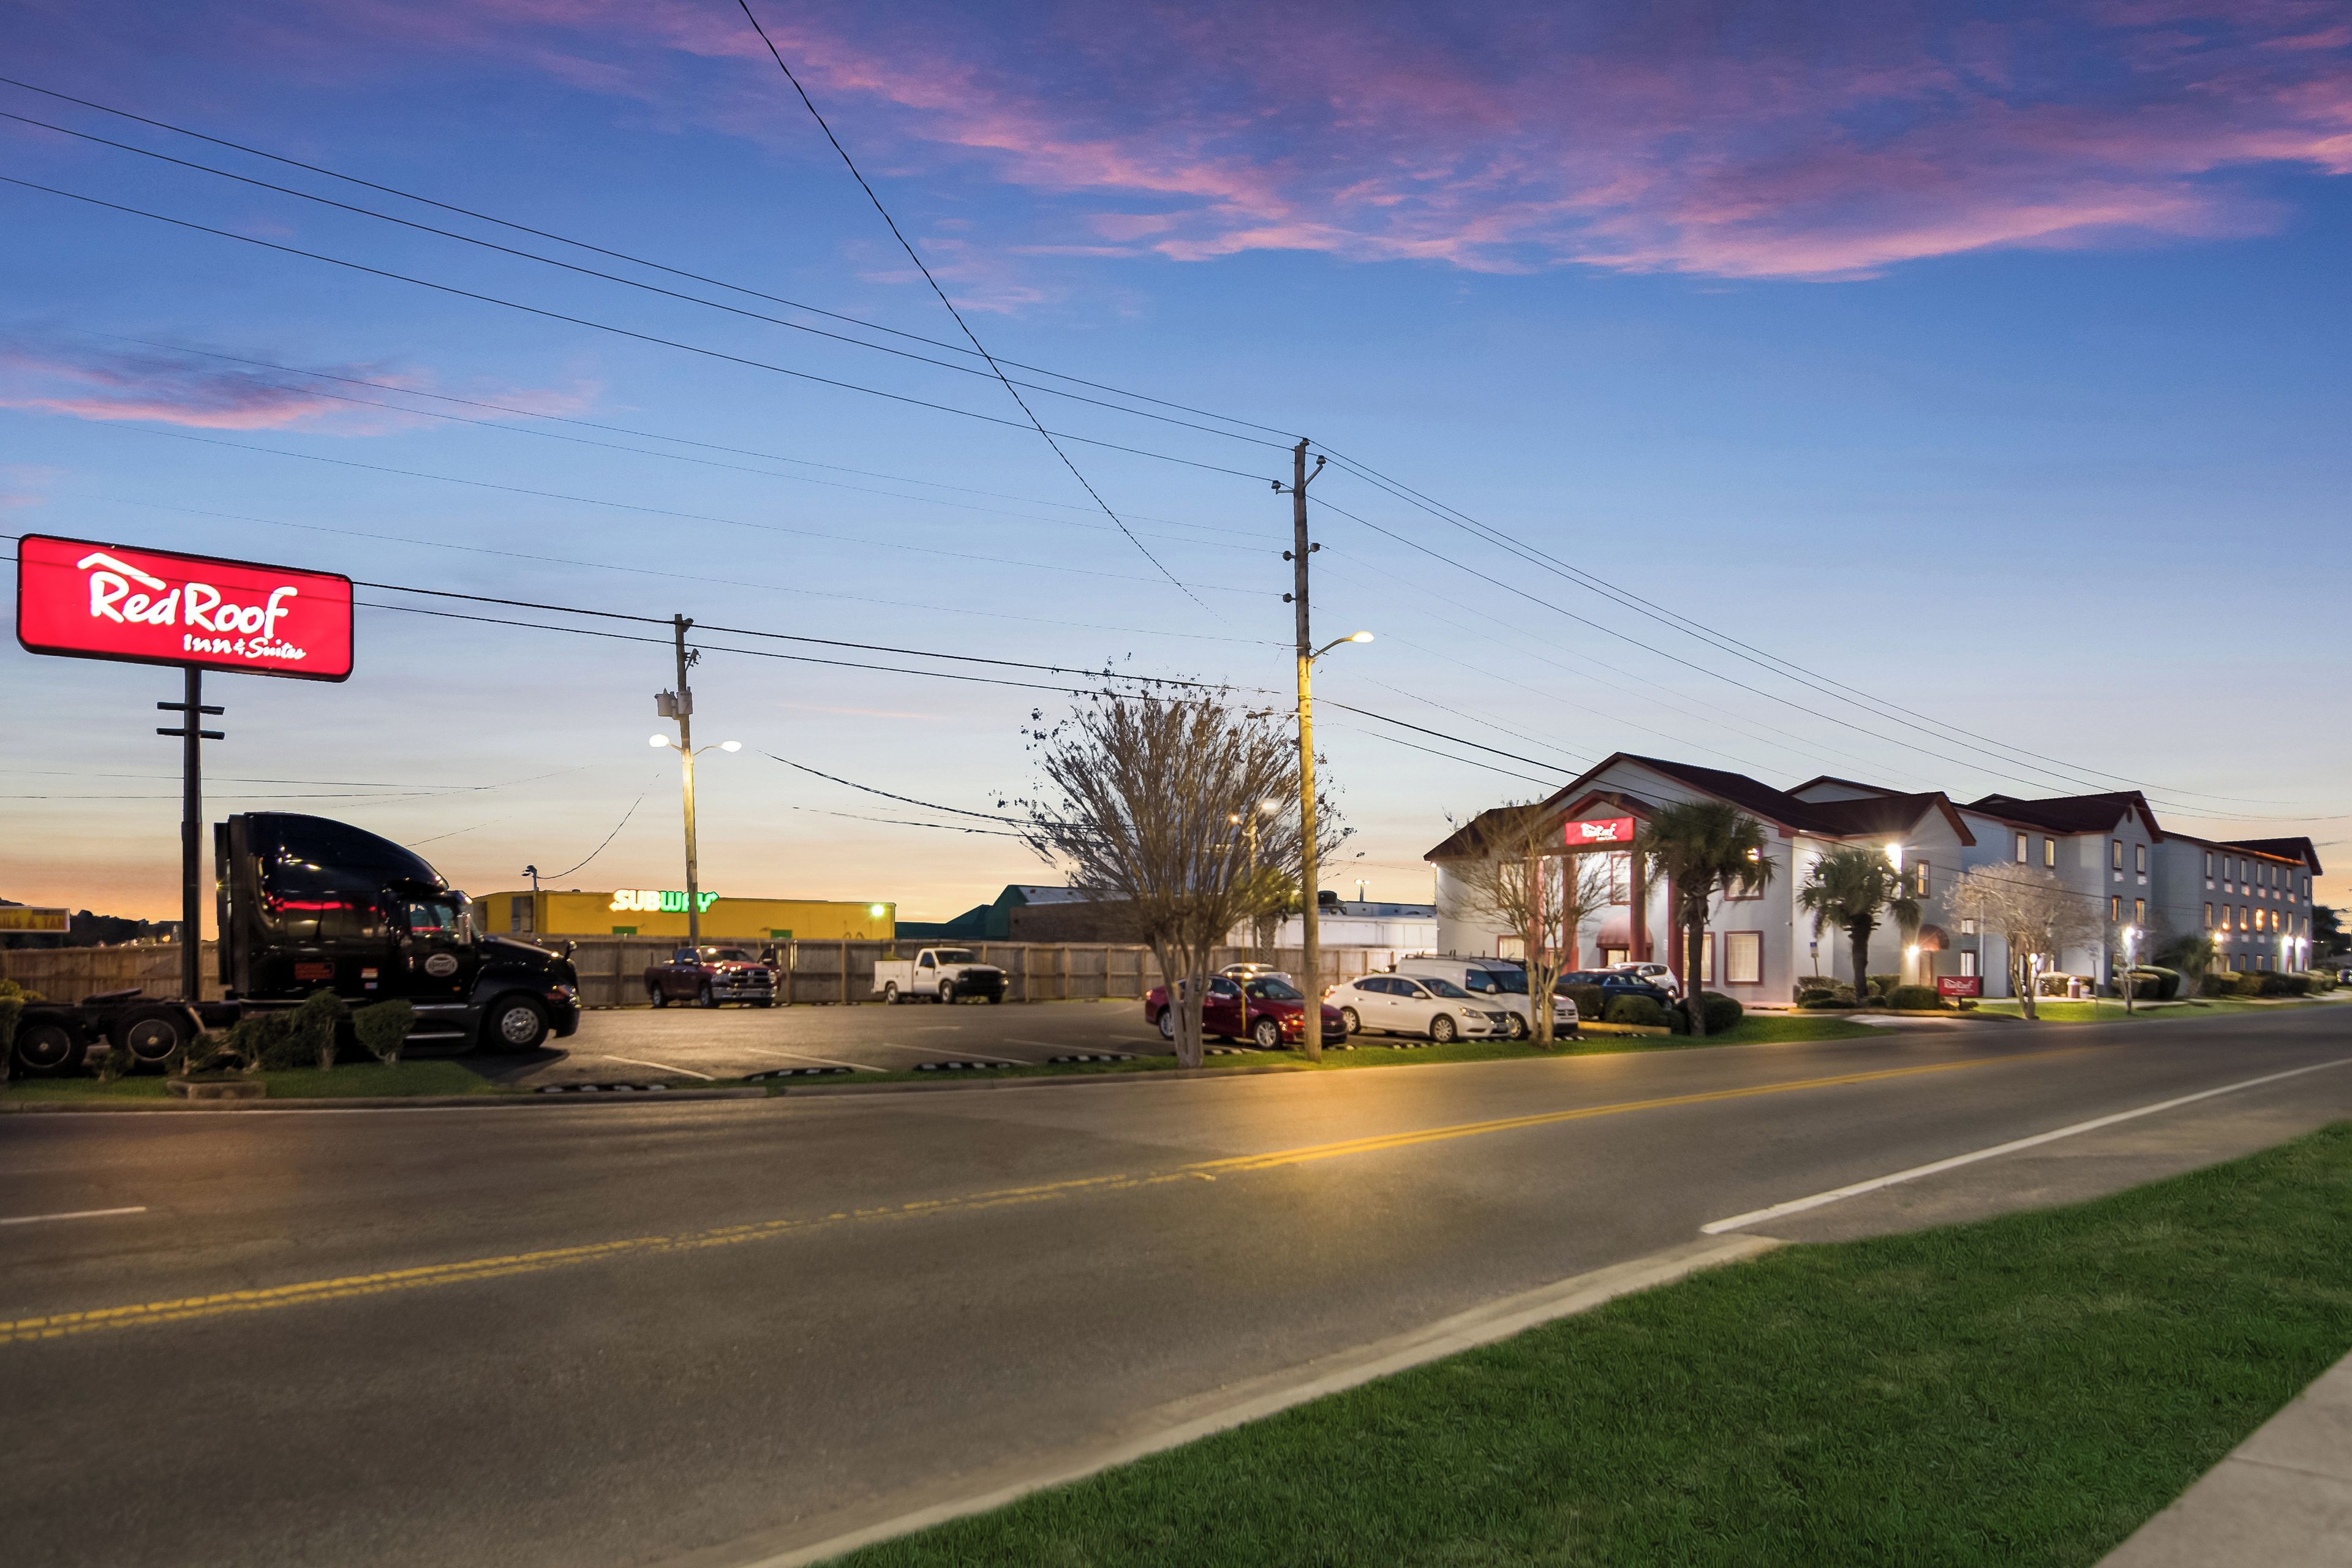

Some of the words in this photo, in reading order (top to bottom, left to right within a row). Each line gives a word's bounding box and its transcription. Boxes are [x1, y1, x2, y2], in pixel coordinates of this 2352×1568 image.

[90, 571, 181, 625] Red
[184, 582, 298, 639] Roof
[184, 634, 233, 654] Inn
[233, 638, 246, 655] &
[244, 636, 307, 660] Suites
